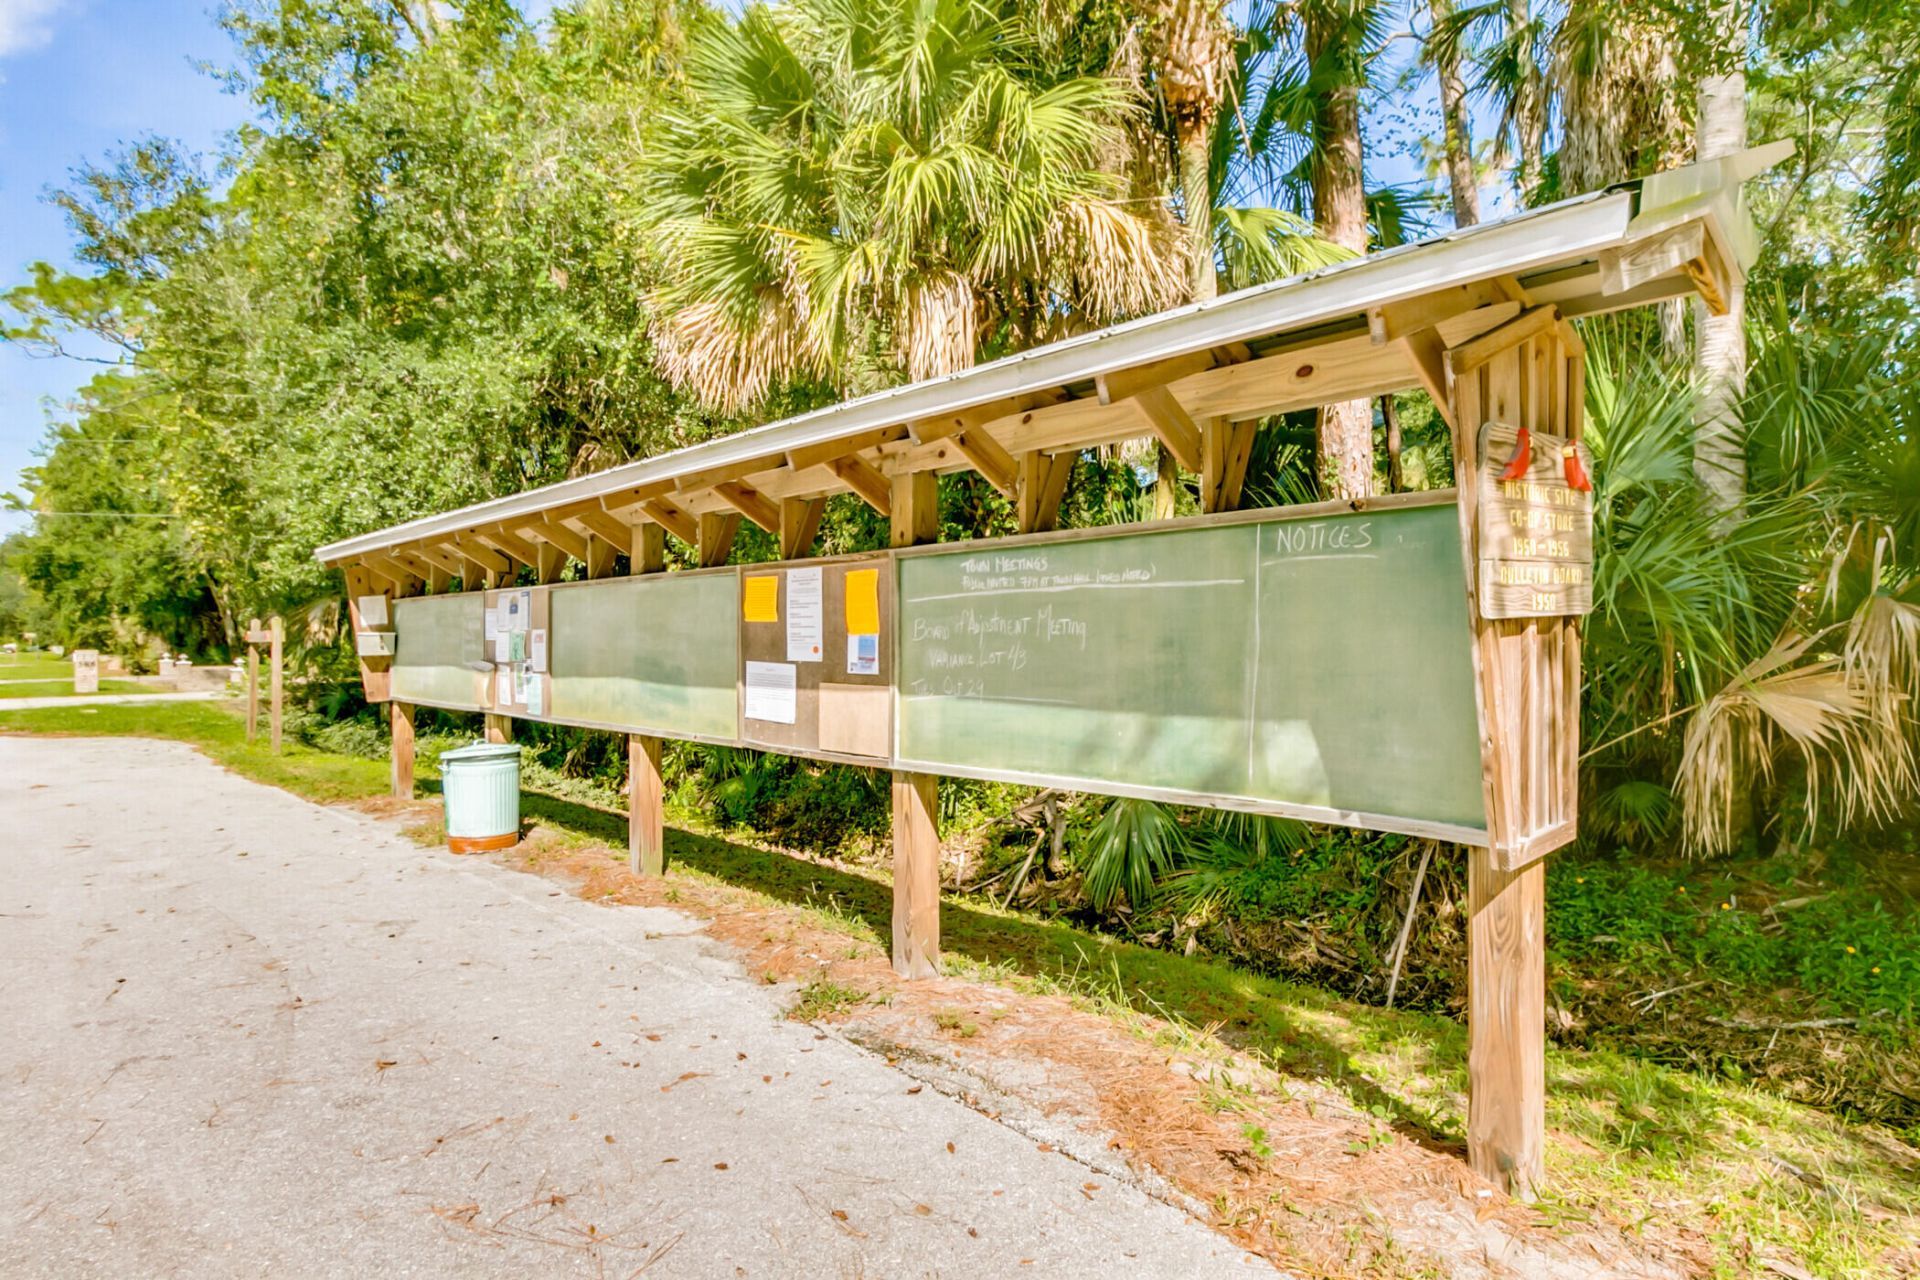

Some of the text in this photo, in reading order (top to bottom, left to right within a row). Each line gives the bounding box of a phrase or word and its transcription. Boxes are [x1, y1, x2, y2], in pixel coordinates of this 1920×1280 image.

[1504, 480, 1576, 506] HISTORIC SITE
[1510, 509, 1575, 532] CO-OP STORE
[1277, 522, 1373, 553] NOTICES
[995, 556, 1048, 573] MEETINGS
[1500, 566, 1582, 585] BULLETIN BOARD
[1531, 592, 1556, 611] 1950
